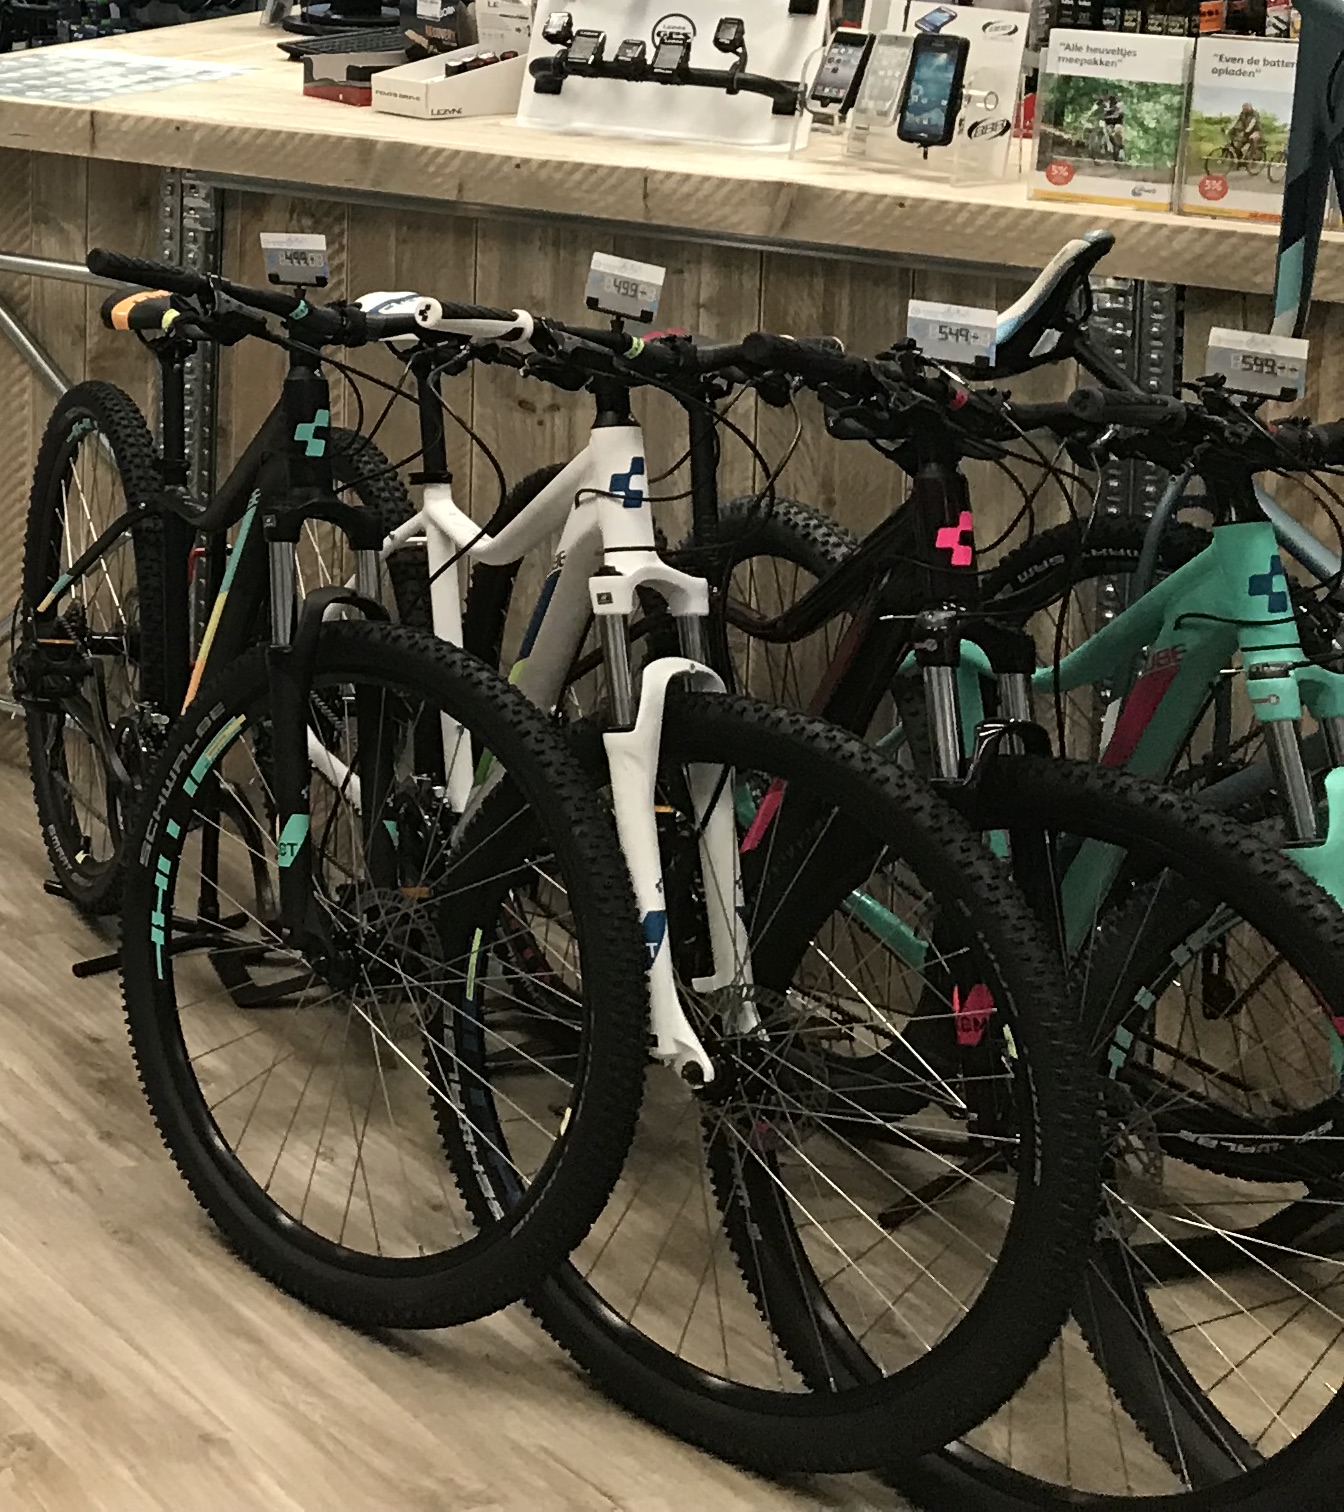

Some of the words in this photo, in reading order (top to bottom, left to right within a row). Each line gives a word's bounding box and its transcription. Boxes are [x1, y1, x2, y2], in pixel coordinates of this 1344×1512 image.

[1085, 44, 1137, 58] heuveltjes
[1247, 55, 1260, 66] de
[1263, 55, 1296, 68] batter
[430, 108, 463, 116] LEZYNE
[1051, 164, 1069, 177] 5%
[1204, 179, 1222, 192] 5%
[139, 701, 226, 868] SCHWALBE
